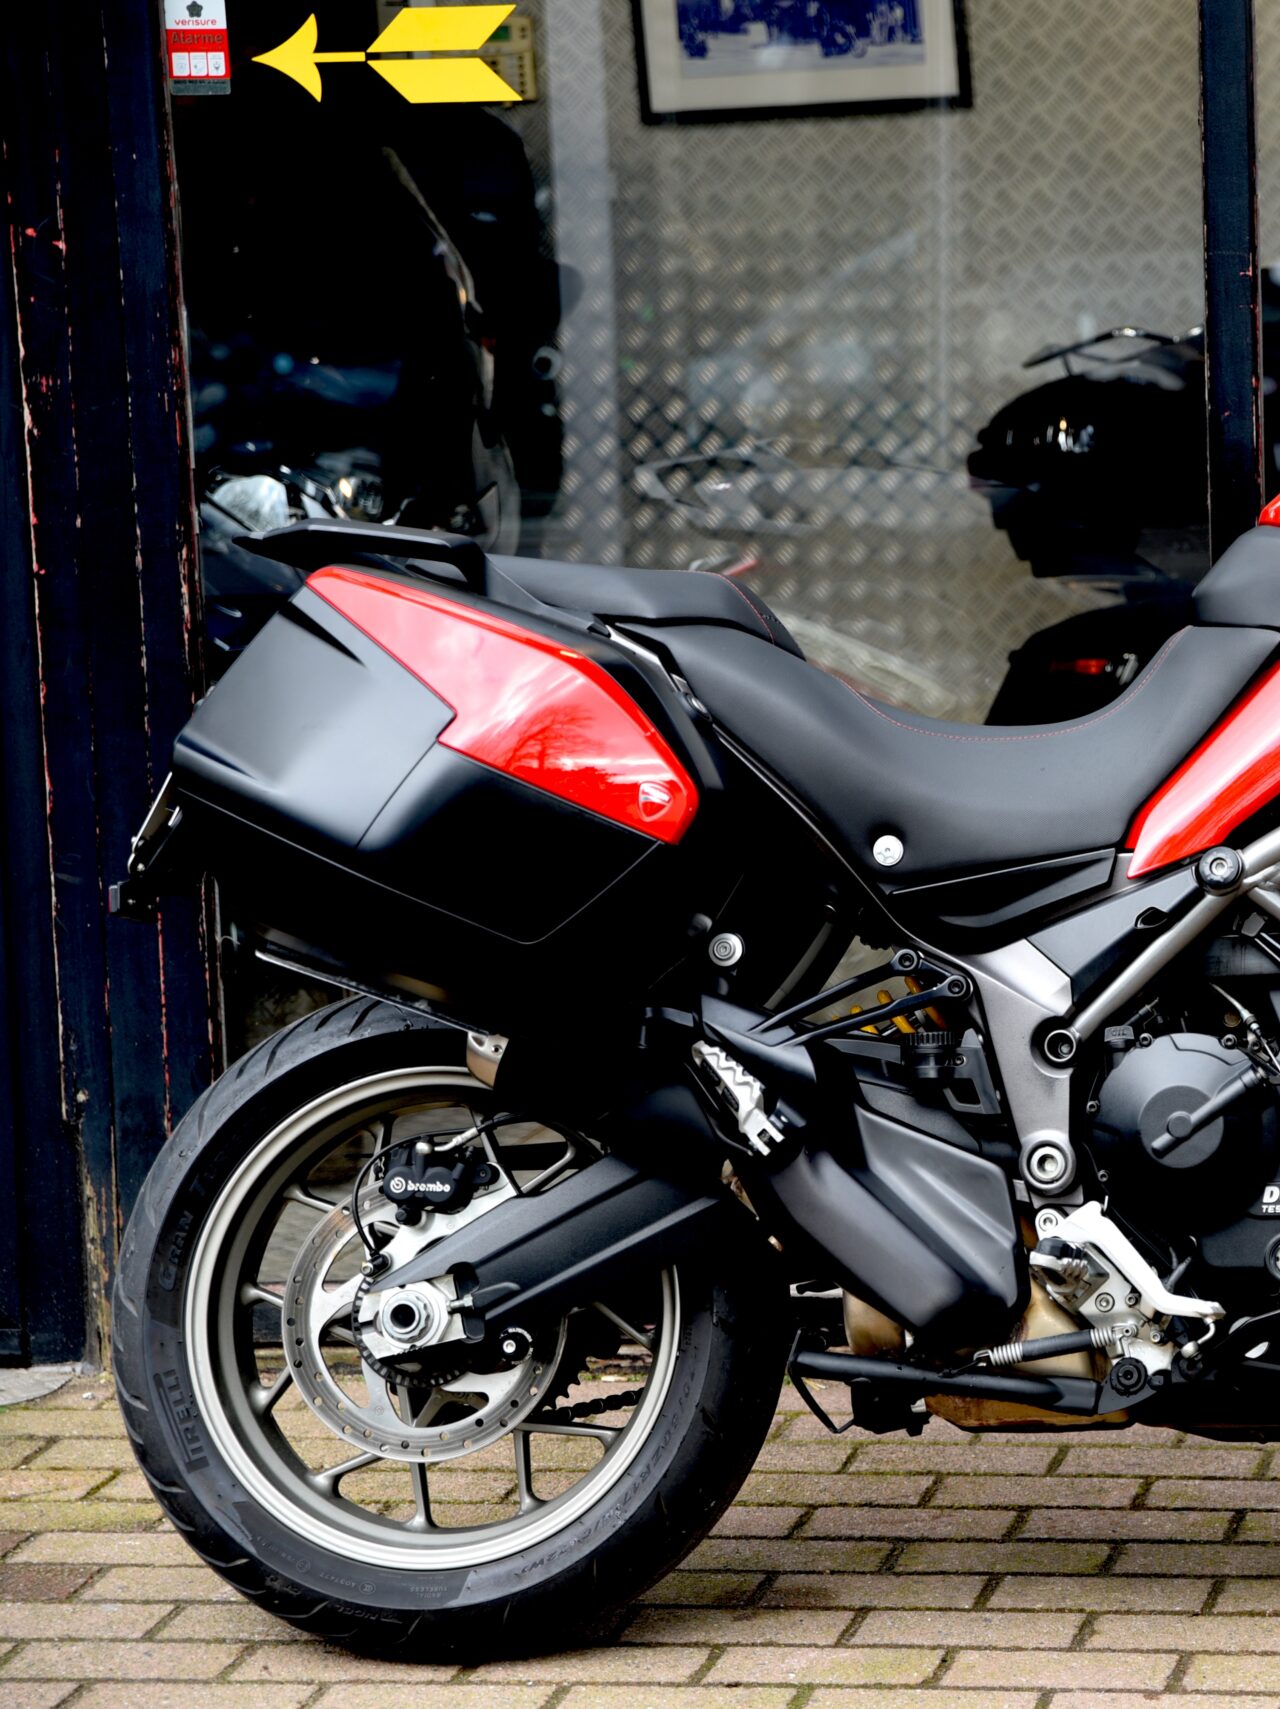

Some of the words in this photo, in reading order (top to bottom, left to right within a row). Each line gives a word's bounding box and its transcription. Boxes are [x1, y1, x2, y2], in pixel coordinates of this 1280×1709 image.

[174, 18, 217, 26] verisure
[172, 31, 224, 45] Alarme
[406, 1179, 452, 1194] brembo
[153, 1369, 211, 1473] PIRELLI
